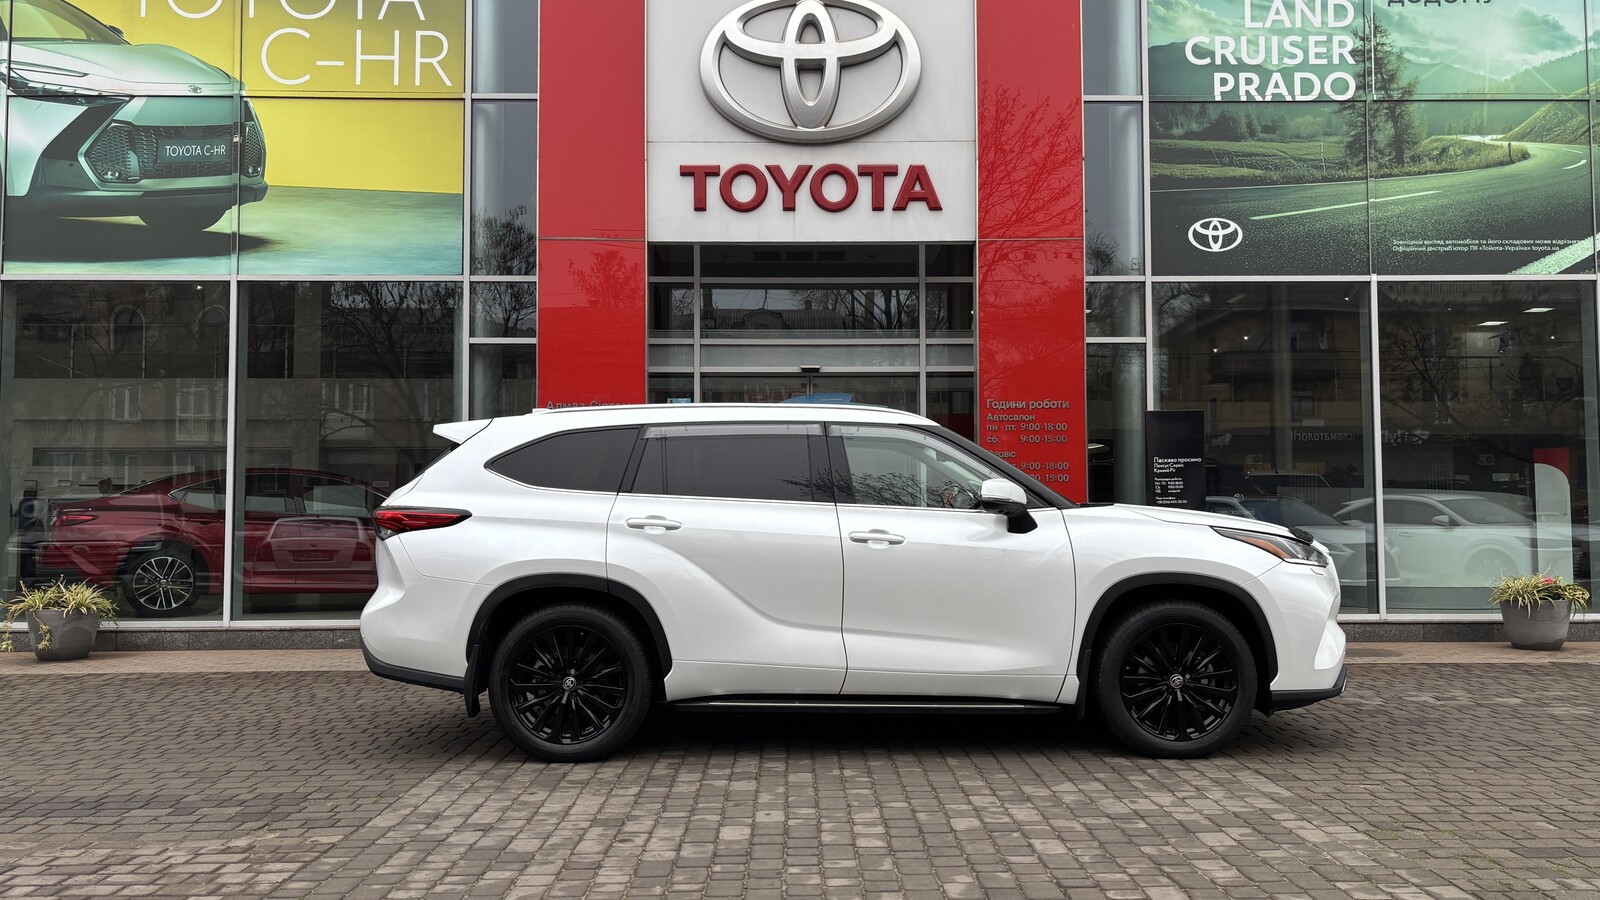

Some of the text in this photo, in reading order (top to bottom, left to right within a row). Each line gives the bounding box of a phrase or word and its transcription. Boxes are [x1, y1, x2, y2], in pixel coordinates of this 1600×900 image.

[1244, 0, 1355, 28] LAND
[261, 27, 453, 87] C-HR
[1185, 35, 1357, 65] CRUISER
[1213, 71, 1356, 101] PRADO
[165, 144, 226, 157] TOYOTA C-HR
[679, 163, 943, 213] TOYOTA
[986, 398, 1070, 411] Години роботи
[986, 413, 1035, 421] Автосалон
[986, 435, 1000, 443] сб.
[989, 450, 1016, 458] ервіс
